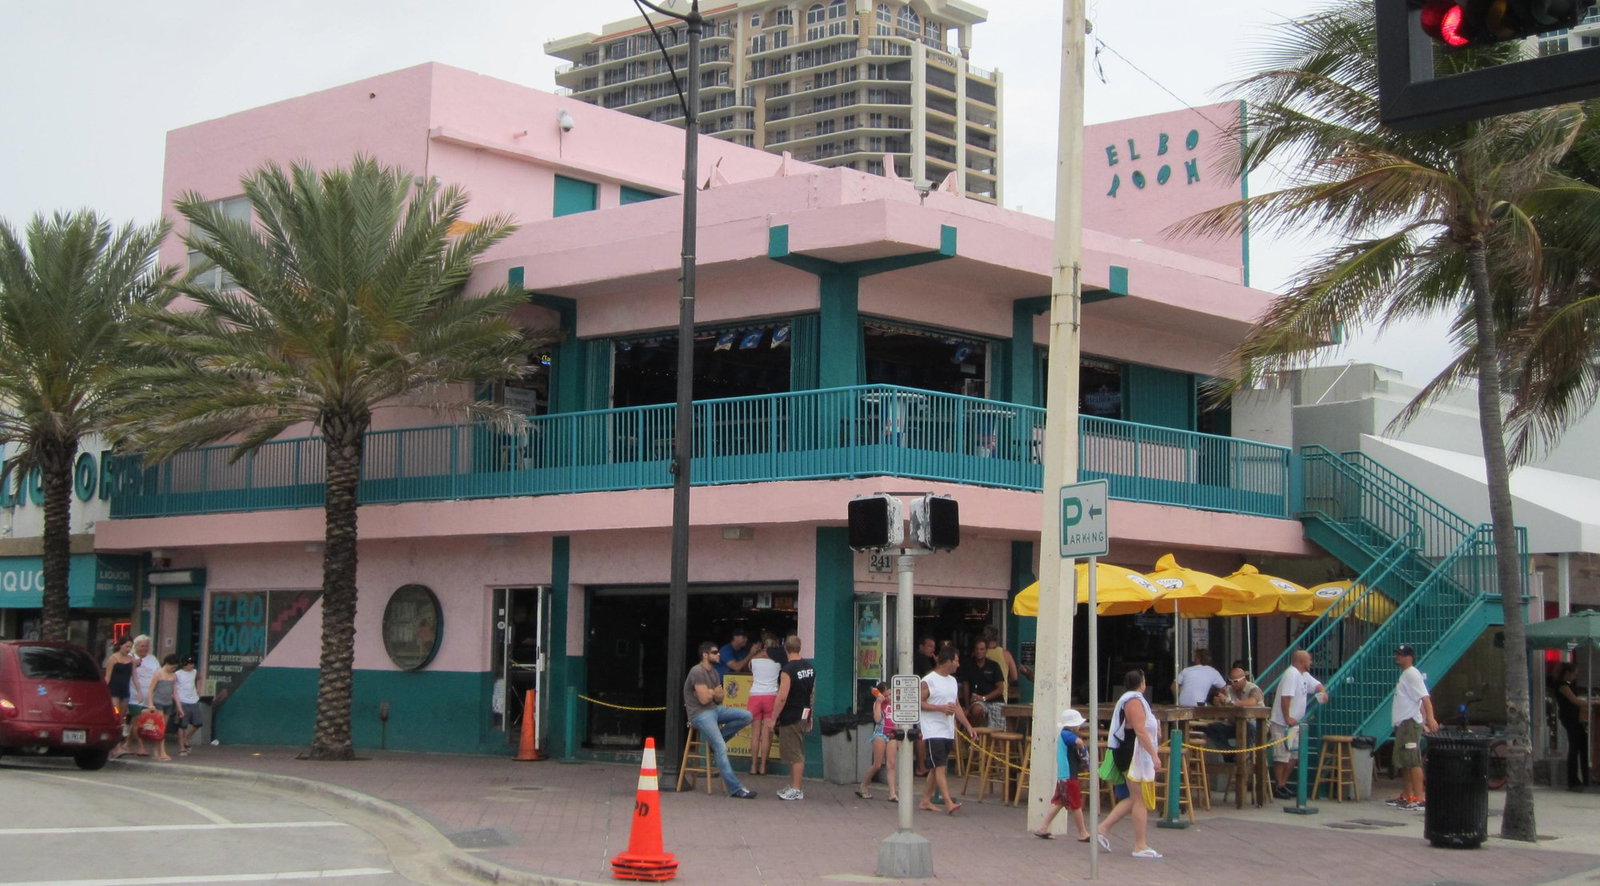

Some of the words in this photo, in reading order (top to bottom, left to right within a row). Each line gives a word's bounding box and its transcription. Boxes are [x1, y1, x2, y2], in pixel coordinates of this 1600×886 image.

[1105, 129, 1200, 166] ELBO
[1106, 157, 1201, 198] ROOM
[1063, 496, 1105, 546] PARKING
[871, 554, 890, 568] 241
[213, 594, 264, 622] ELBO
[214, 625, 266, 653] ROOM
